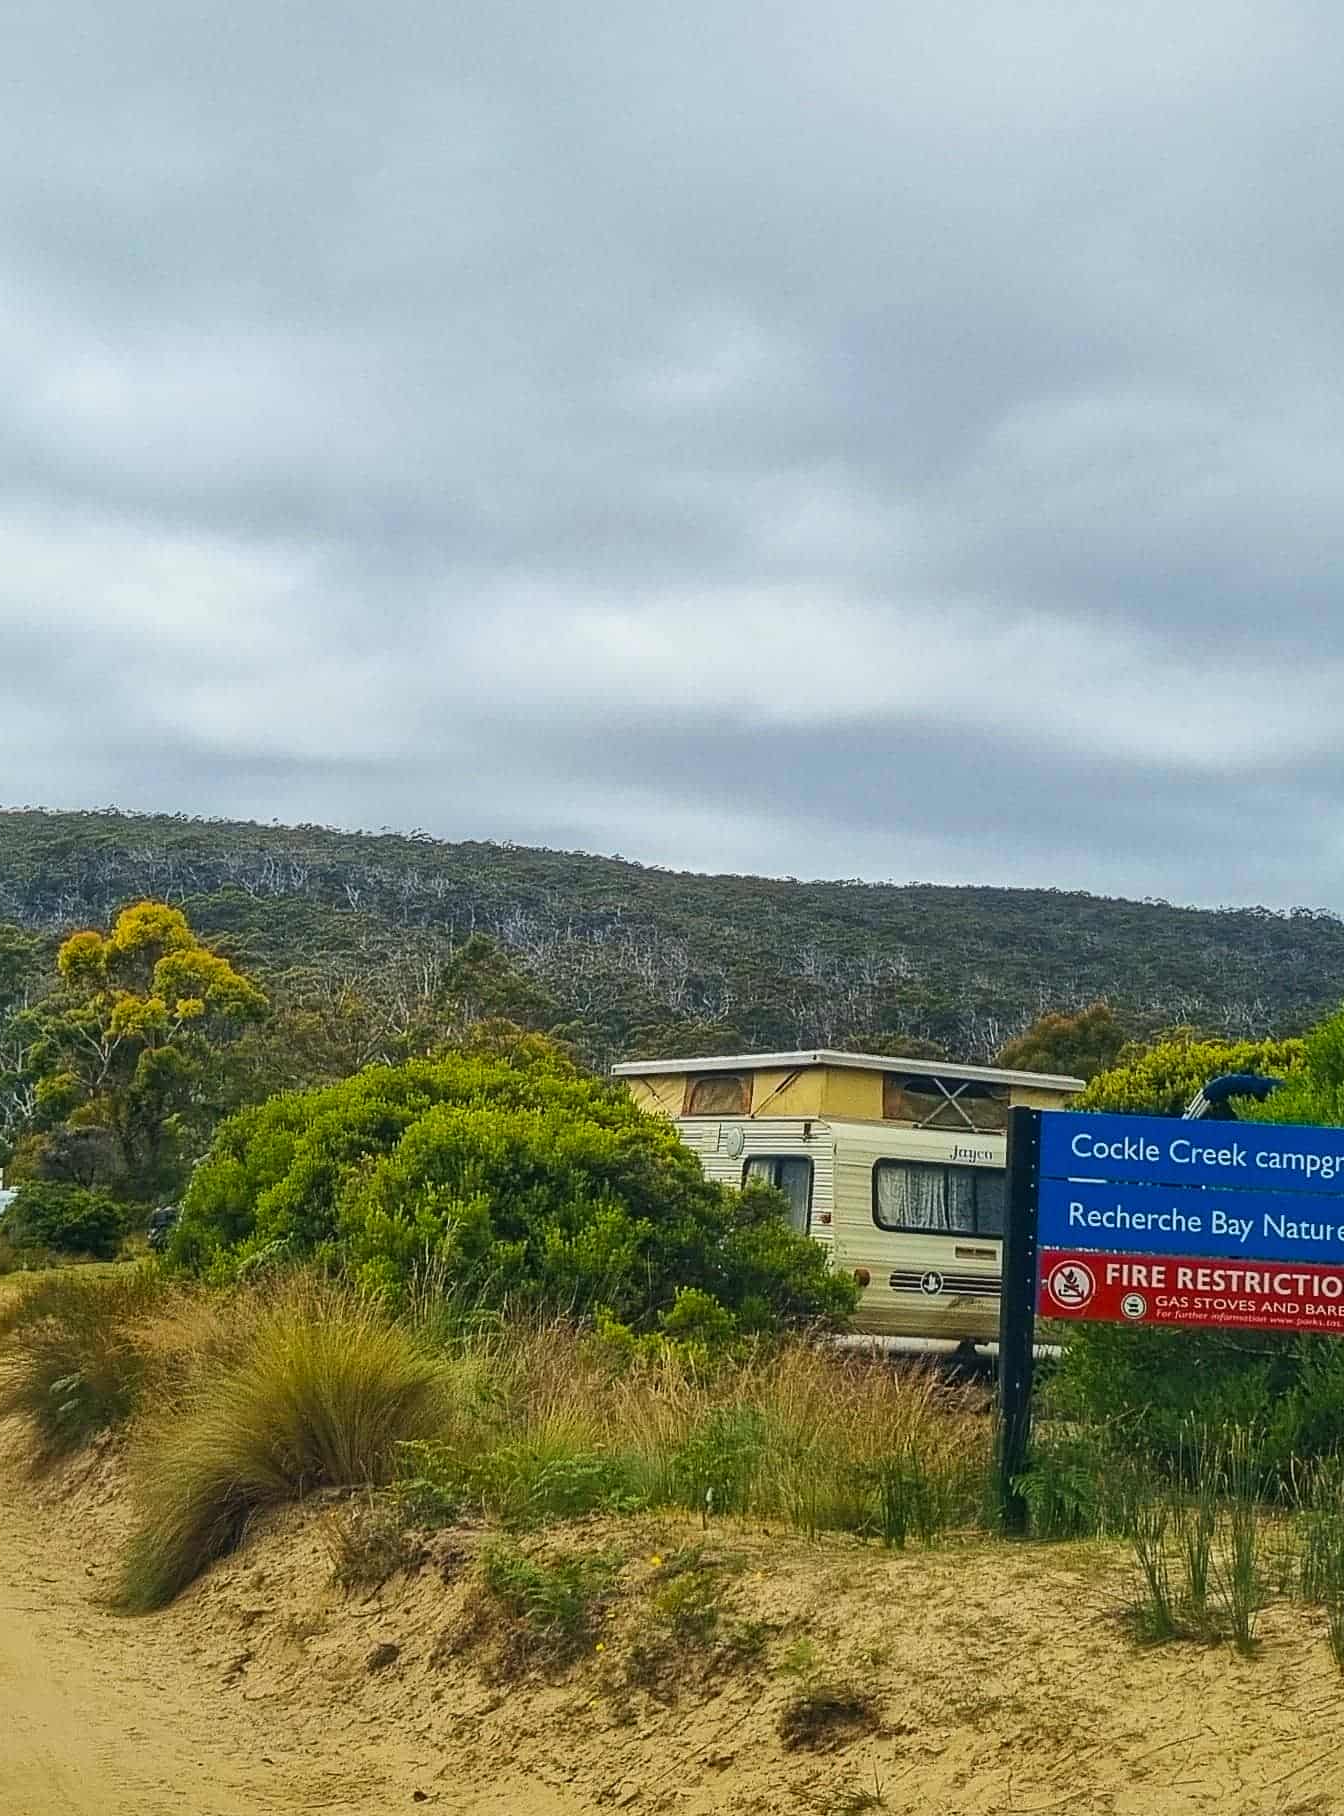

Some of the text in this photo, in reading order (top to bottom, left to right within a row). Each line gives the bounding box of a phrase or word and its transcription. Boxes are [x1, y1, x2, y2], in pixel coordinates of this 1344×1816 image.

[1071, 1133, 1160, 1161] Cockle
[1169, 1139, 1248, 1167] Creek
[1069, 1202, 1202, 1233] Recherche
[1212, 1211, 1254, 1243] Bay
[1105, 1263, 1166, 1288] FIRE
[1155, 1295, 1189, 1309] GAS
[1193, 1297, 1256, 1312] STOVES
[1261, 1301, 1300, 1315] AND
[1156, 1309, 1172, 1318] For
[1175, 1310, 1207, 1320] further
[1211, 1311, 1267, 1323] information
